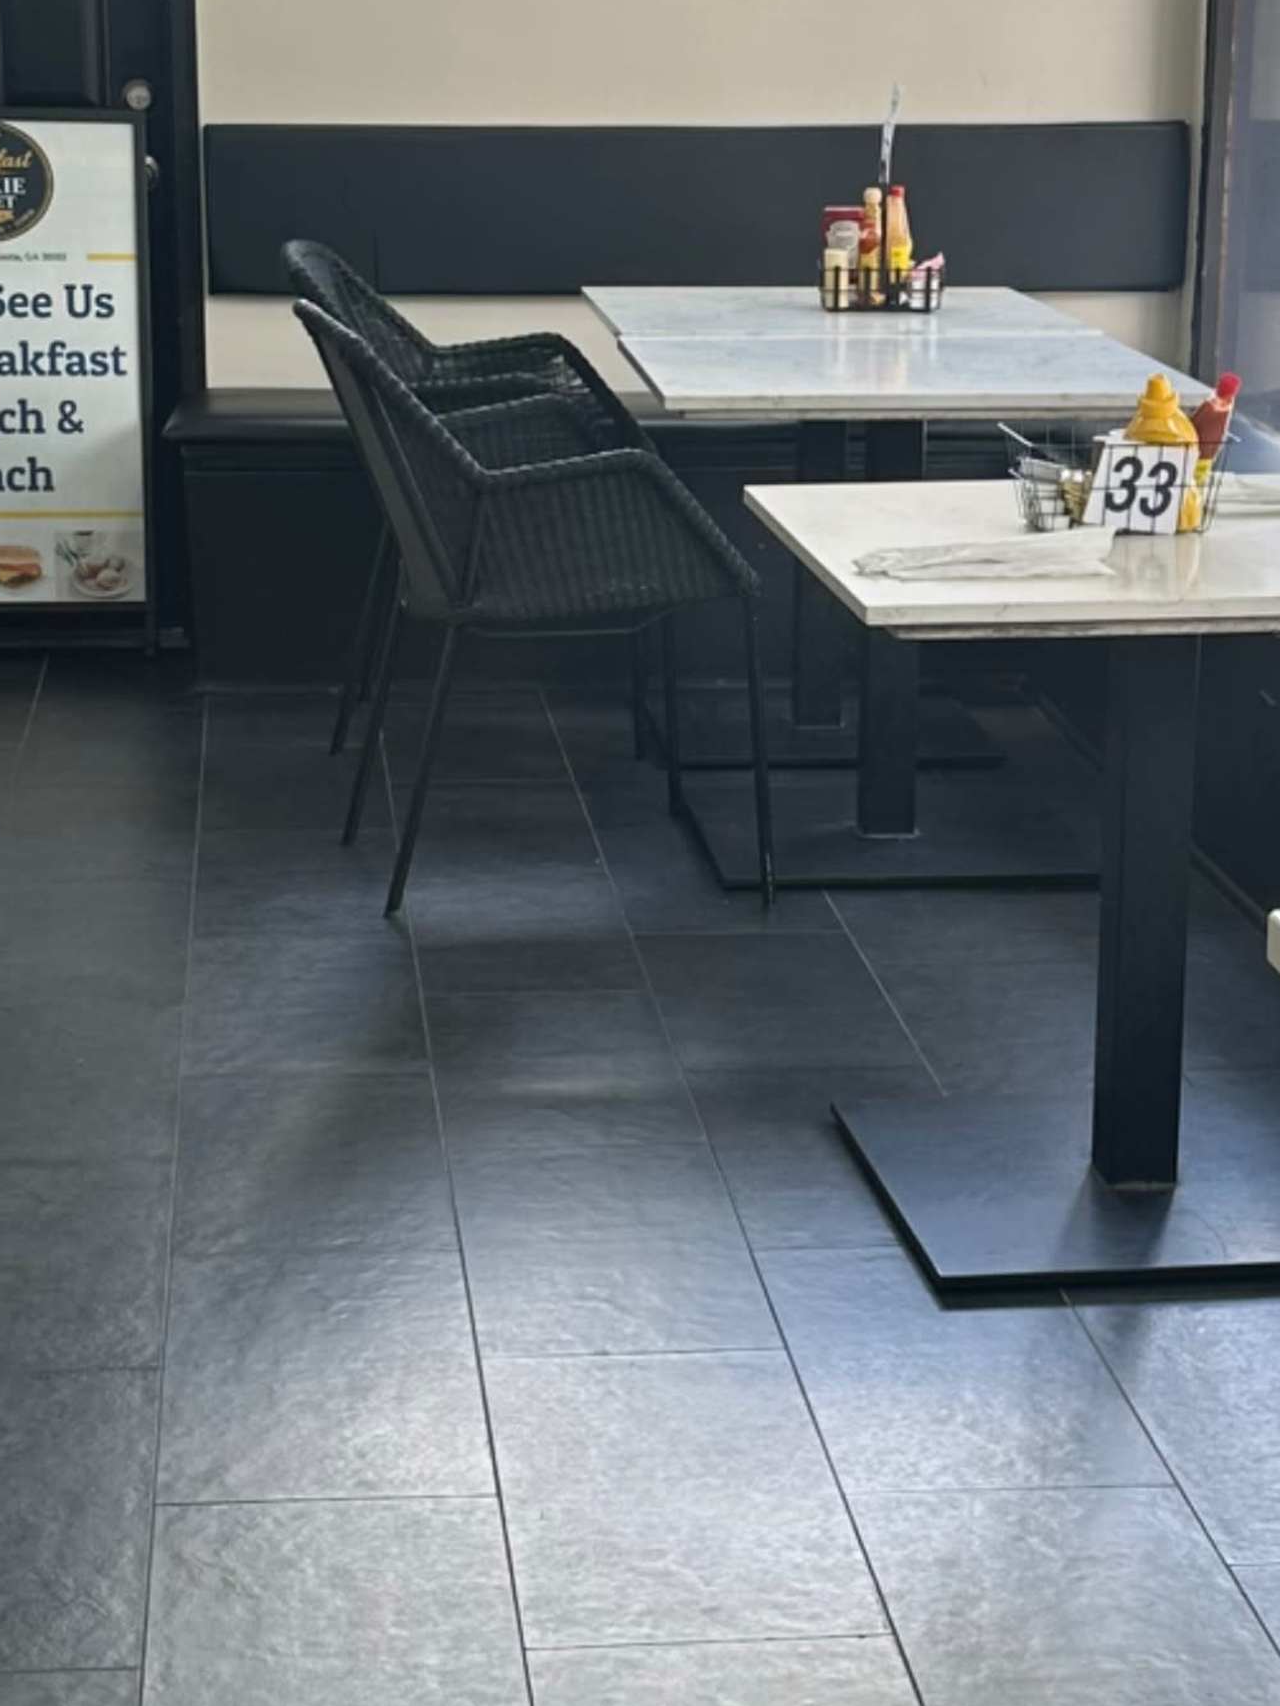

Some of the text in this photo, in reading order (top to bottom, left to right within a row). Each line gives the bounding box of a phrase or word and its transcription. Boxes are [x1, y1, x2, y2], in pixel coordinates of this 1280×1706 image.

[63, 284, 115, 318] Us
[57, 401, 84, 435] &
[1104, 455, 1178, 518] 33
